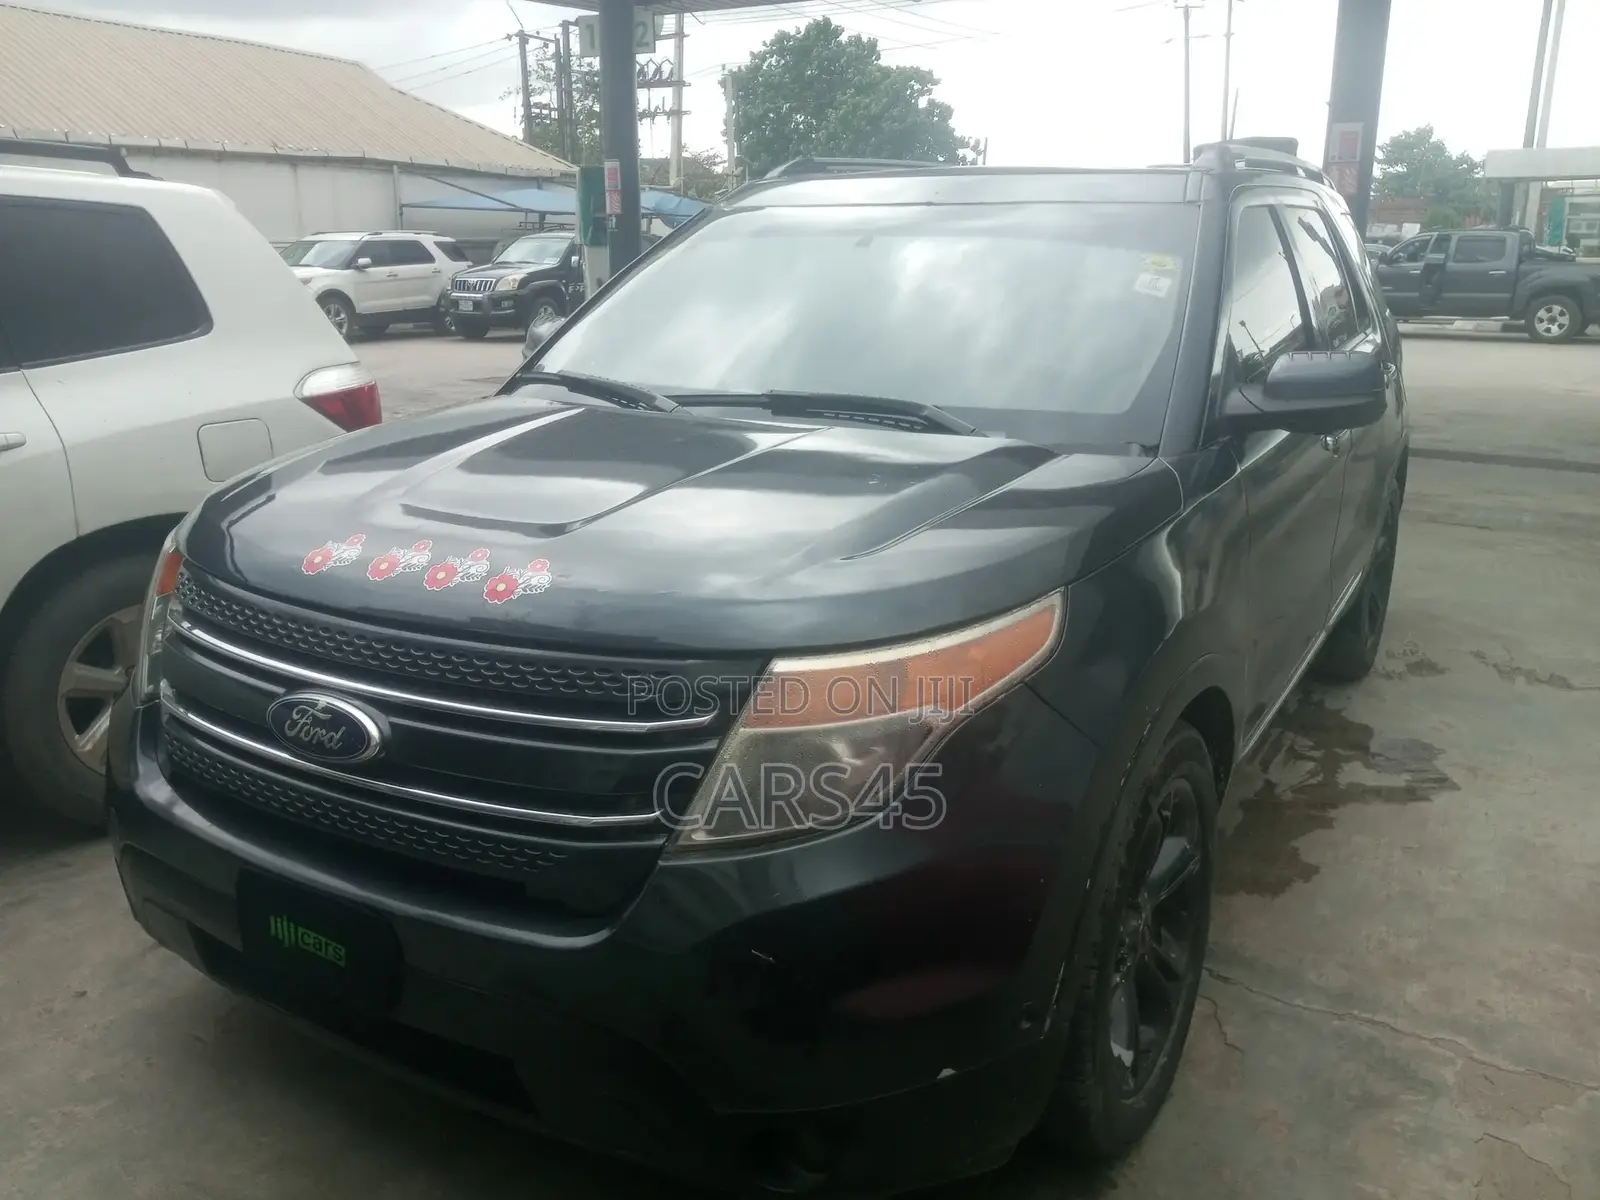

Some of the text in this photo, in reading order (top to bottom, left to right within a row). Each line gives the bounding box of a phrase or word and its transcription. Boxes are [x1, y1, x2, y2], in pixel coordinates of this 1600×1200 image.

[584, 22, 596, 51] 1
[635, 20, 651, 48] 2
[284, 704, 347, 750] Ford
